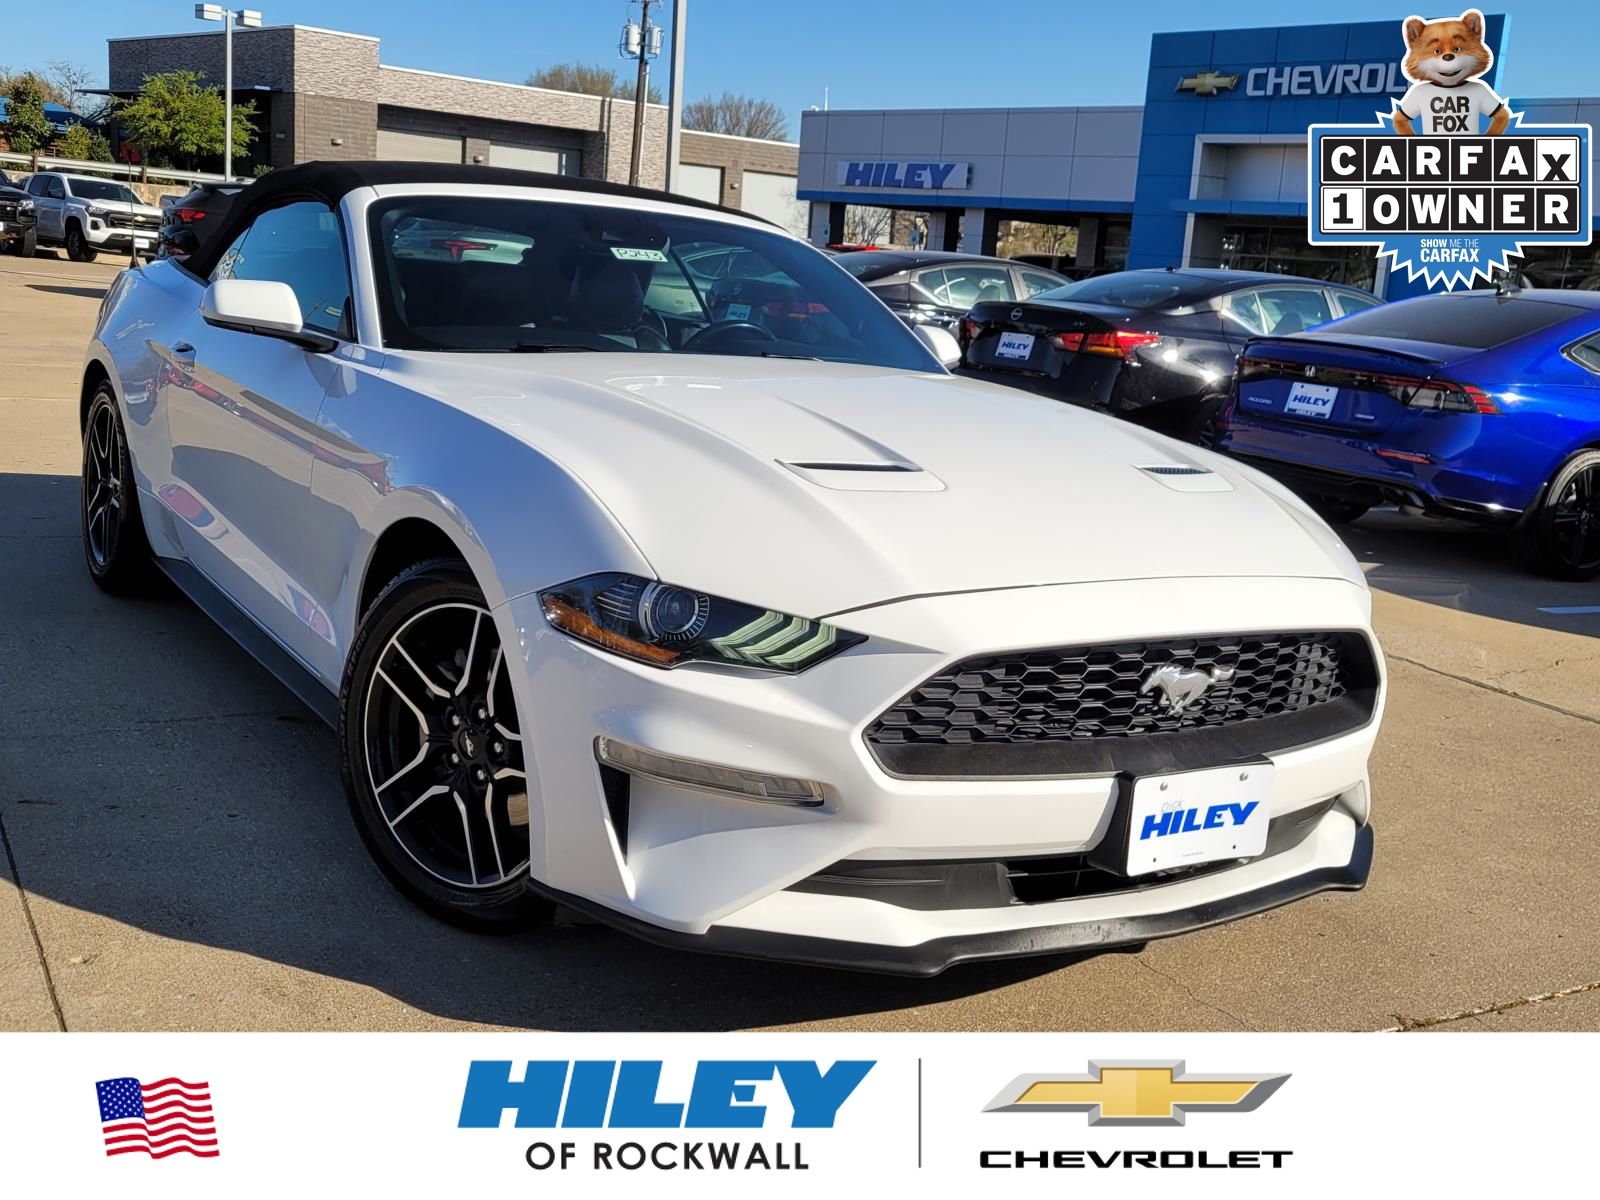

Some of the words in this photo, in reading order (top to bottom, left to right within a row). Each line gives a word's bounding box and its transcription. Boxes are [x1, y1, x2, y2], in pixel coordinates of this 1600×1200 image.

[1246, 63, 1408, 96] CHEVROL
[844, 162, 957, 189] HILEY
[1292, 394, 1330, 407] HILEY
[1140, 801, 1260, 841] HILEY
